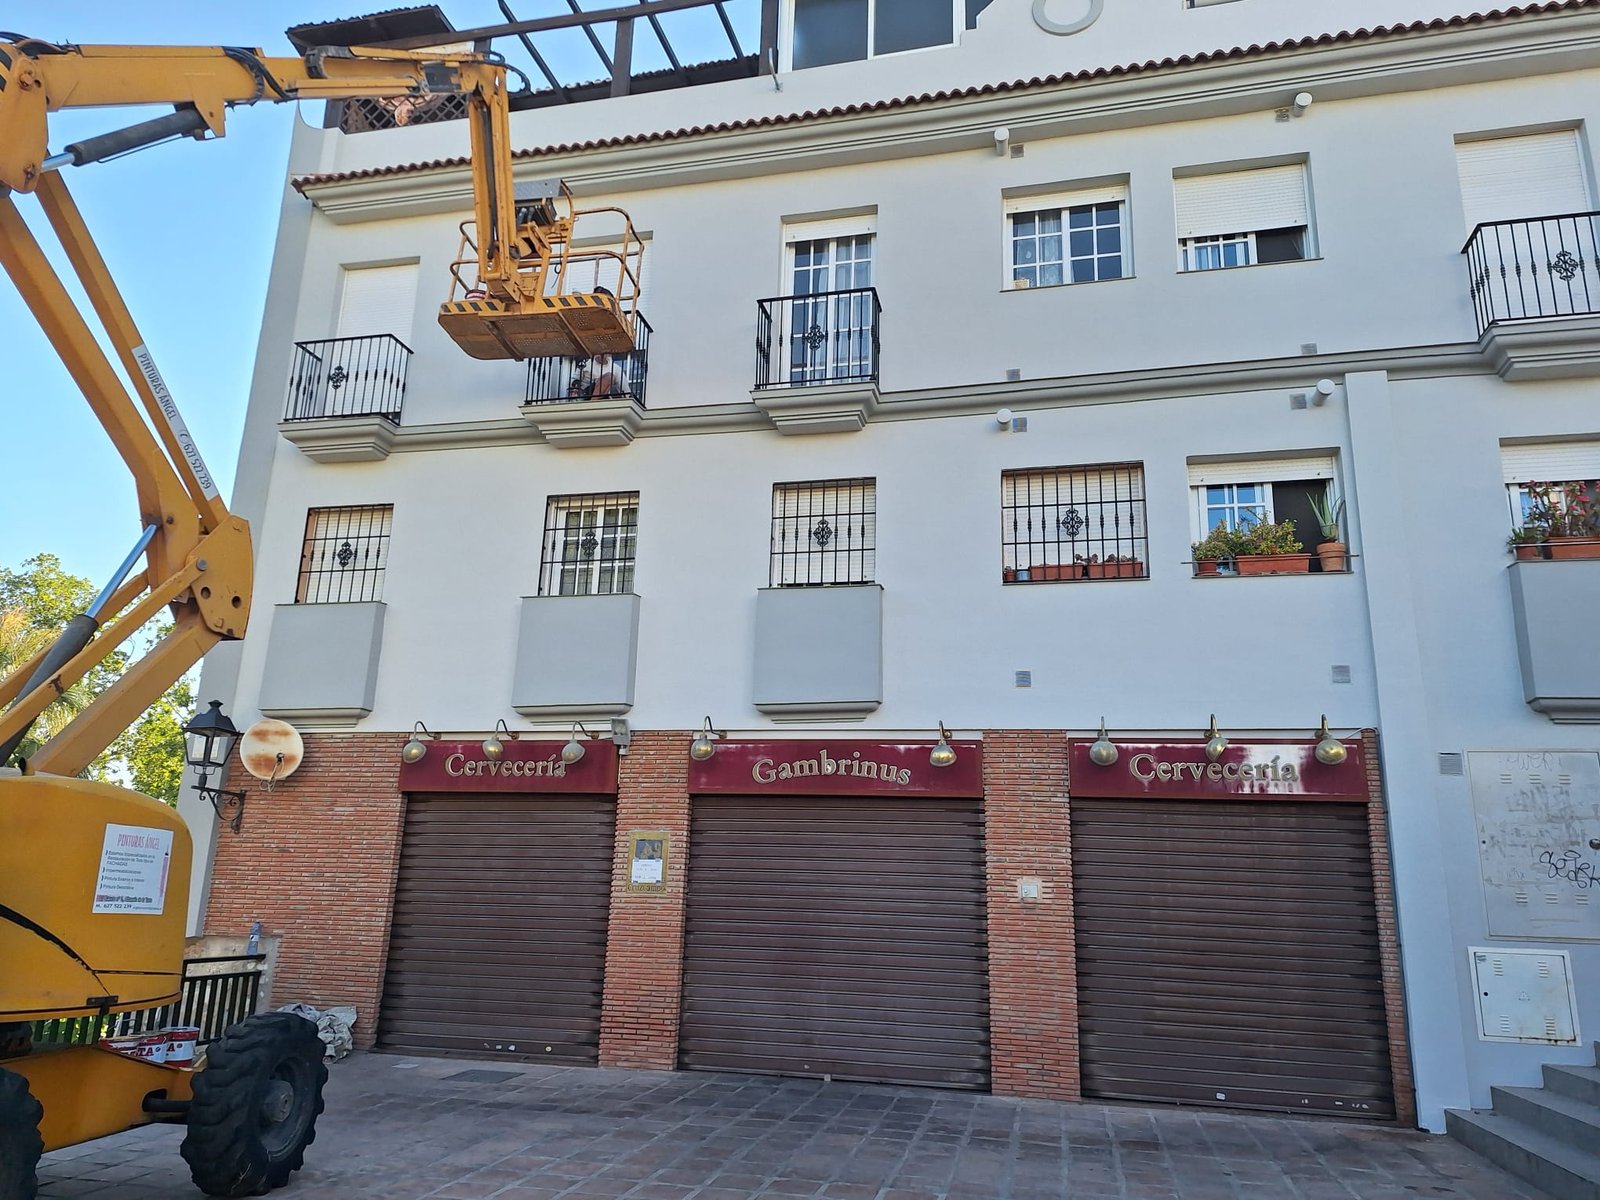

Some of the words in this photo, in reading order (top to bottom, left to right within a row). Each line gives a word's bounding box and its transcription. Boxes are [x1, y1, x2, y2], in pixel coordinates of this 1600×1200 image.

[138, 353, 164, 394] PINTURAS
[184, 444, 196, 459] 627
[191, 458, 204, 474] 522
[200, 474, 212, 490] 239
[445, 754, 567, 778] Cervecería
[752, 749, 912, 786] Gambrinus
[1130, 754, 1298, 782] Cervecería
[116, 834, 144, 848] PINTURAS
